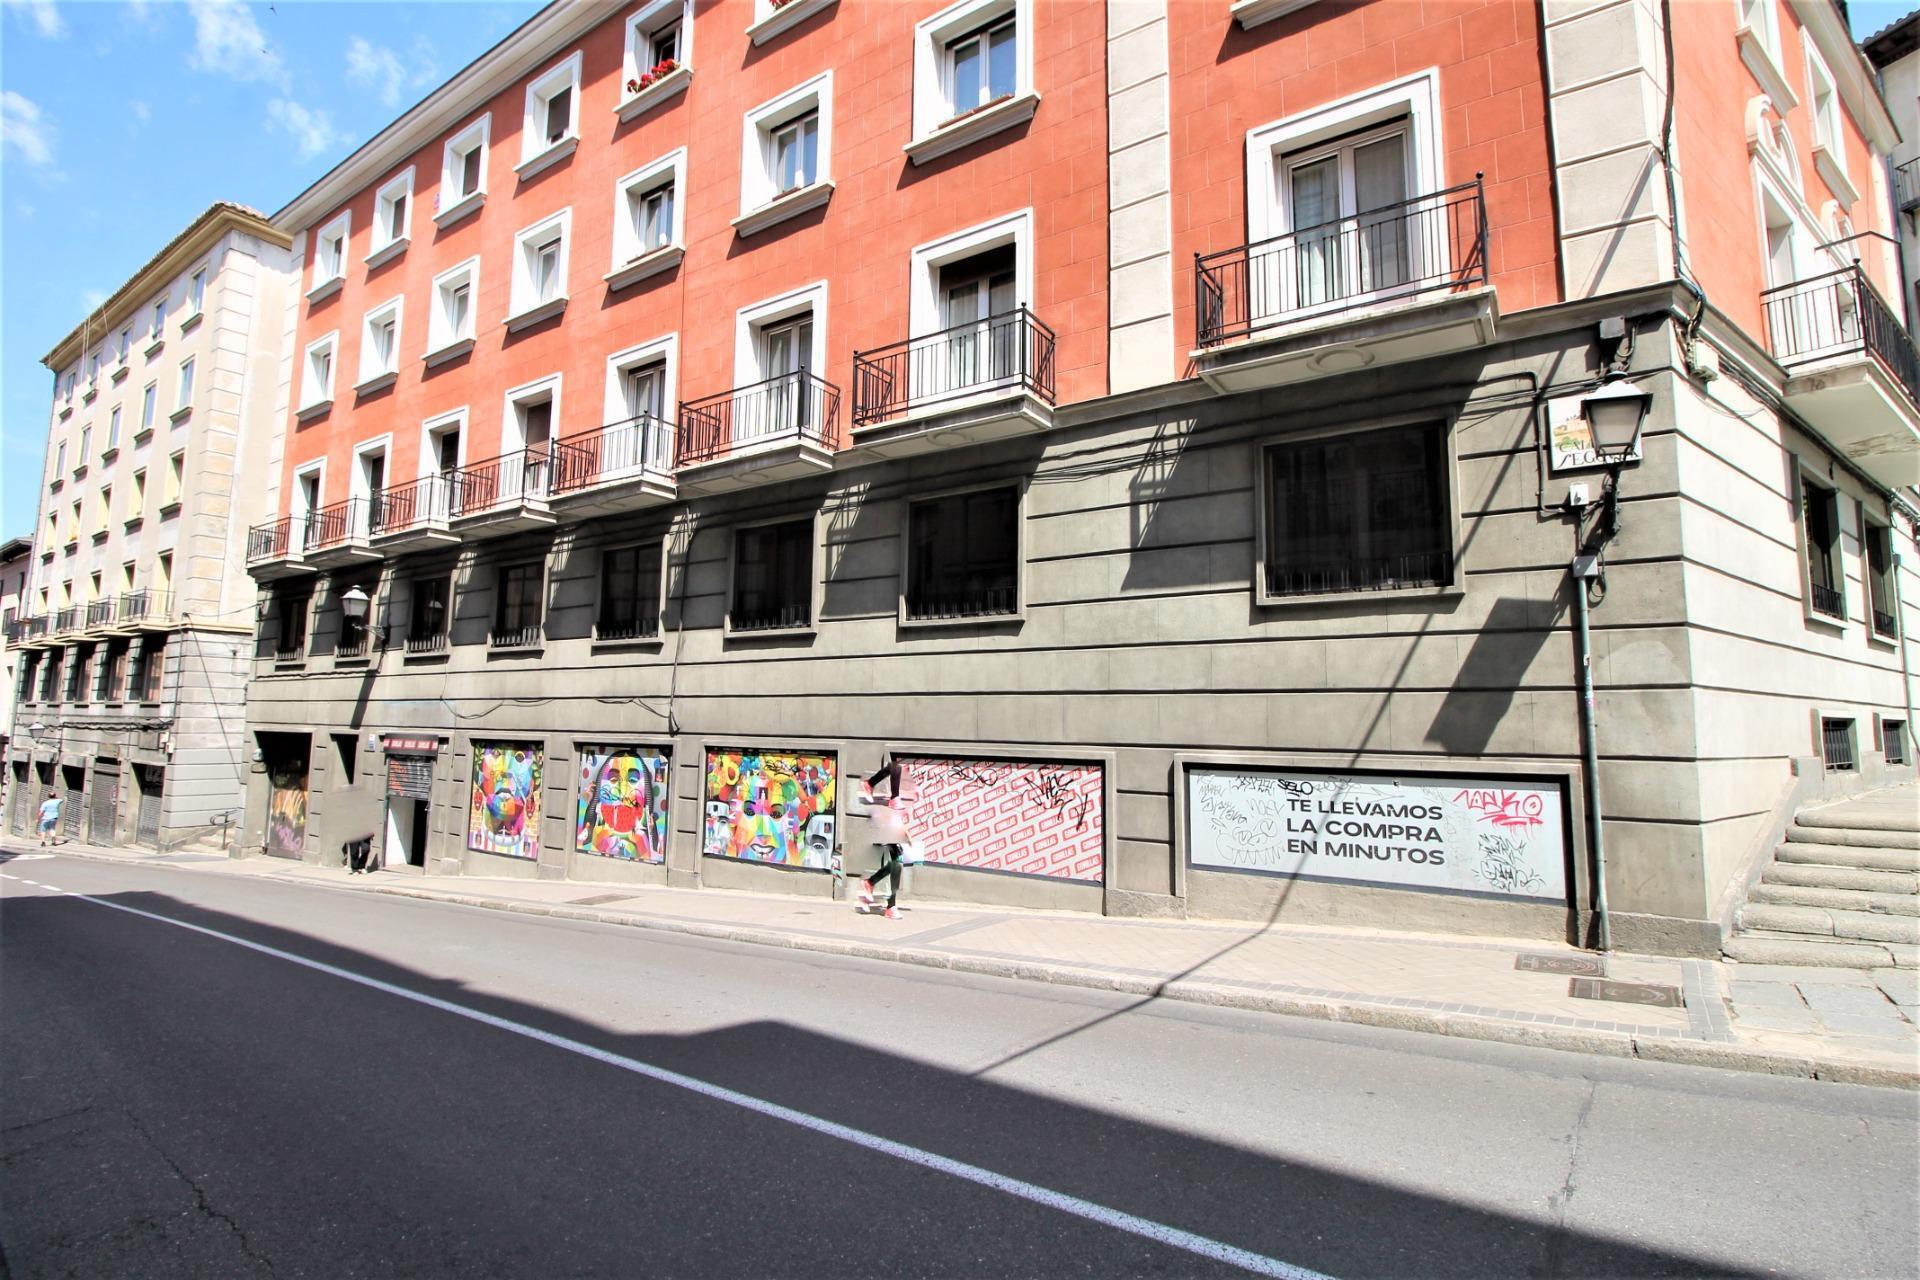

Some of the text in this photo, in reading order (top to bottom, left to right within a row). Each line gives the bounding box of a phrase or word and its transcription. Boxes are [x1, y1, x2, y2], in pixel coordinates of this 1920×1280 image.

[1286, 798, 1443, 820] TE LLEVAMOS
[1286, 818, 1444, 843] LA COMPRA
[1287, 838, 1446, 866] EN MINUTOS
